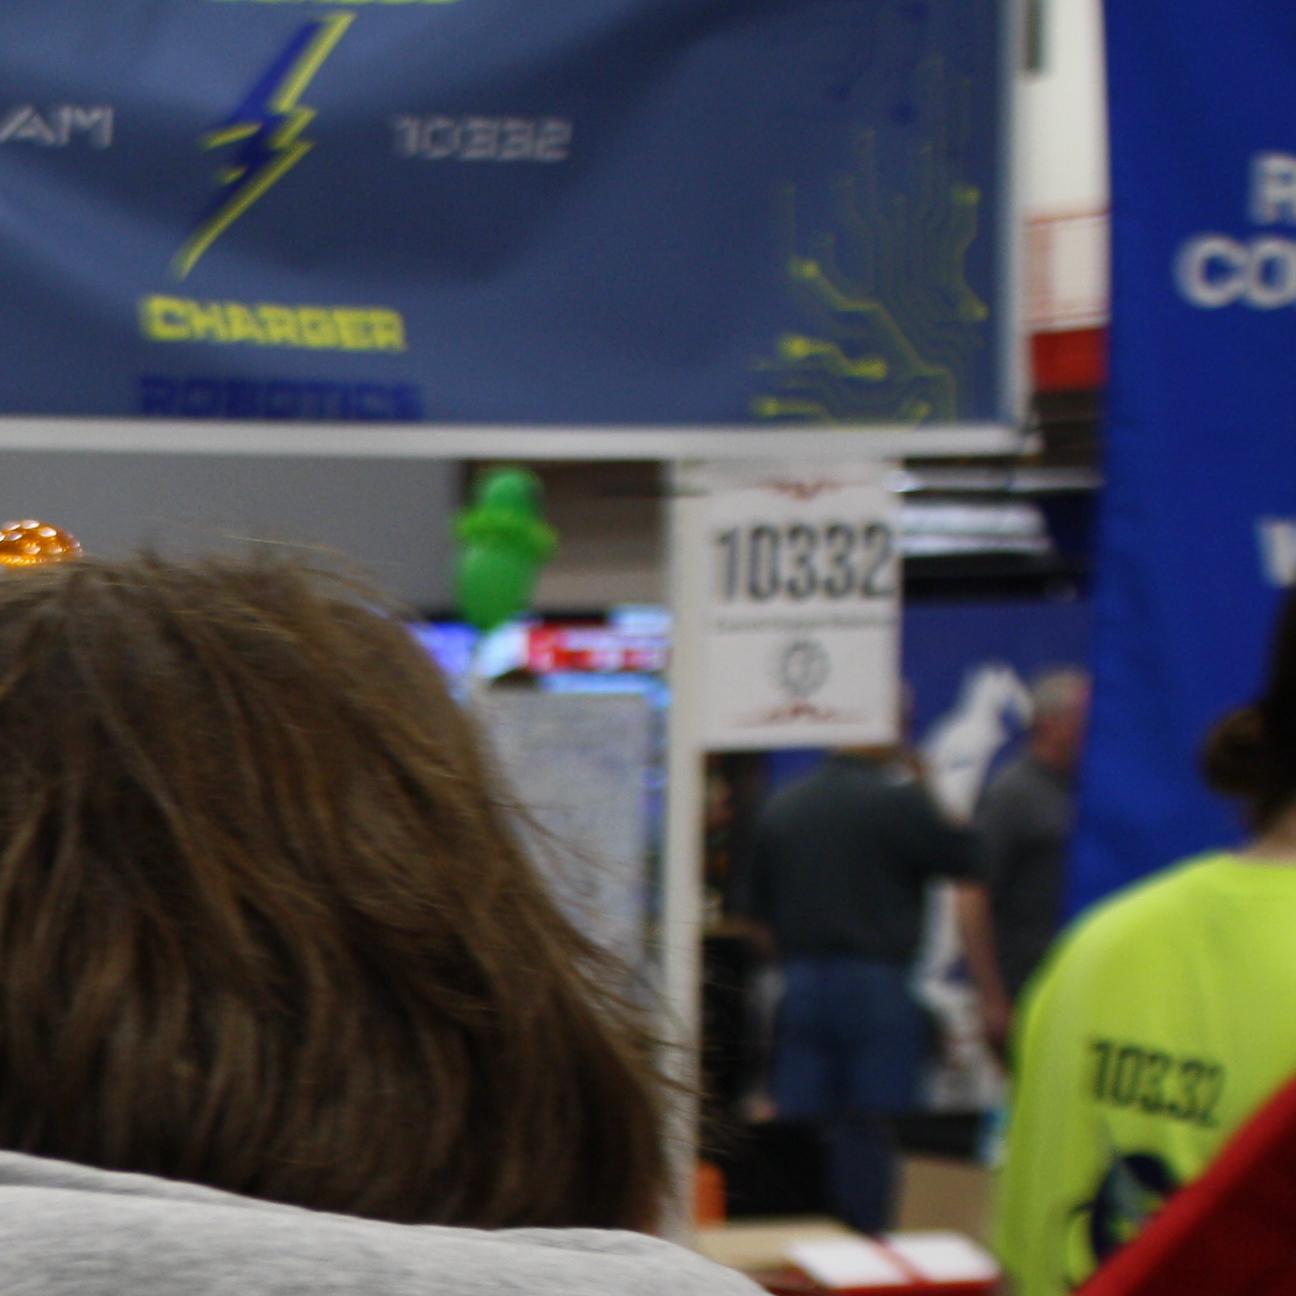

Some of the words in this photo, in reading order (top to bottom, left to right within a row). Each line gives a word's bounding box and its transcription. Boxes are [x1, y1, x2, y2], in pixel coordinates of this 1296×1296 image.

[392, 114, 573, 161] 10332
[140, 294, 406, 352] CHARGER
[716, 522, 897, 602] 10332
[1090, 1036, 1225, 1130] 10332
